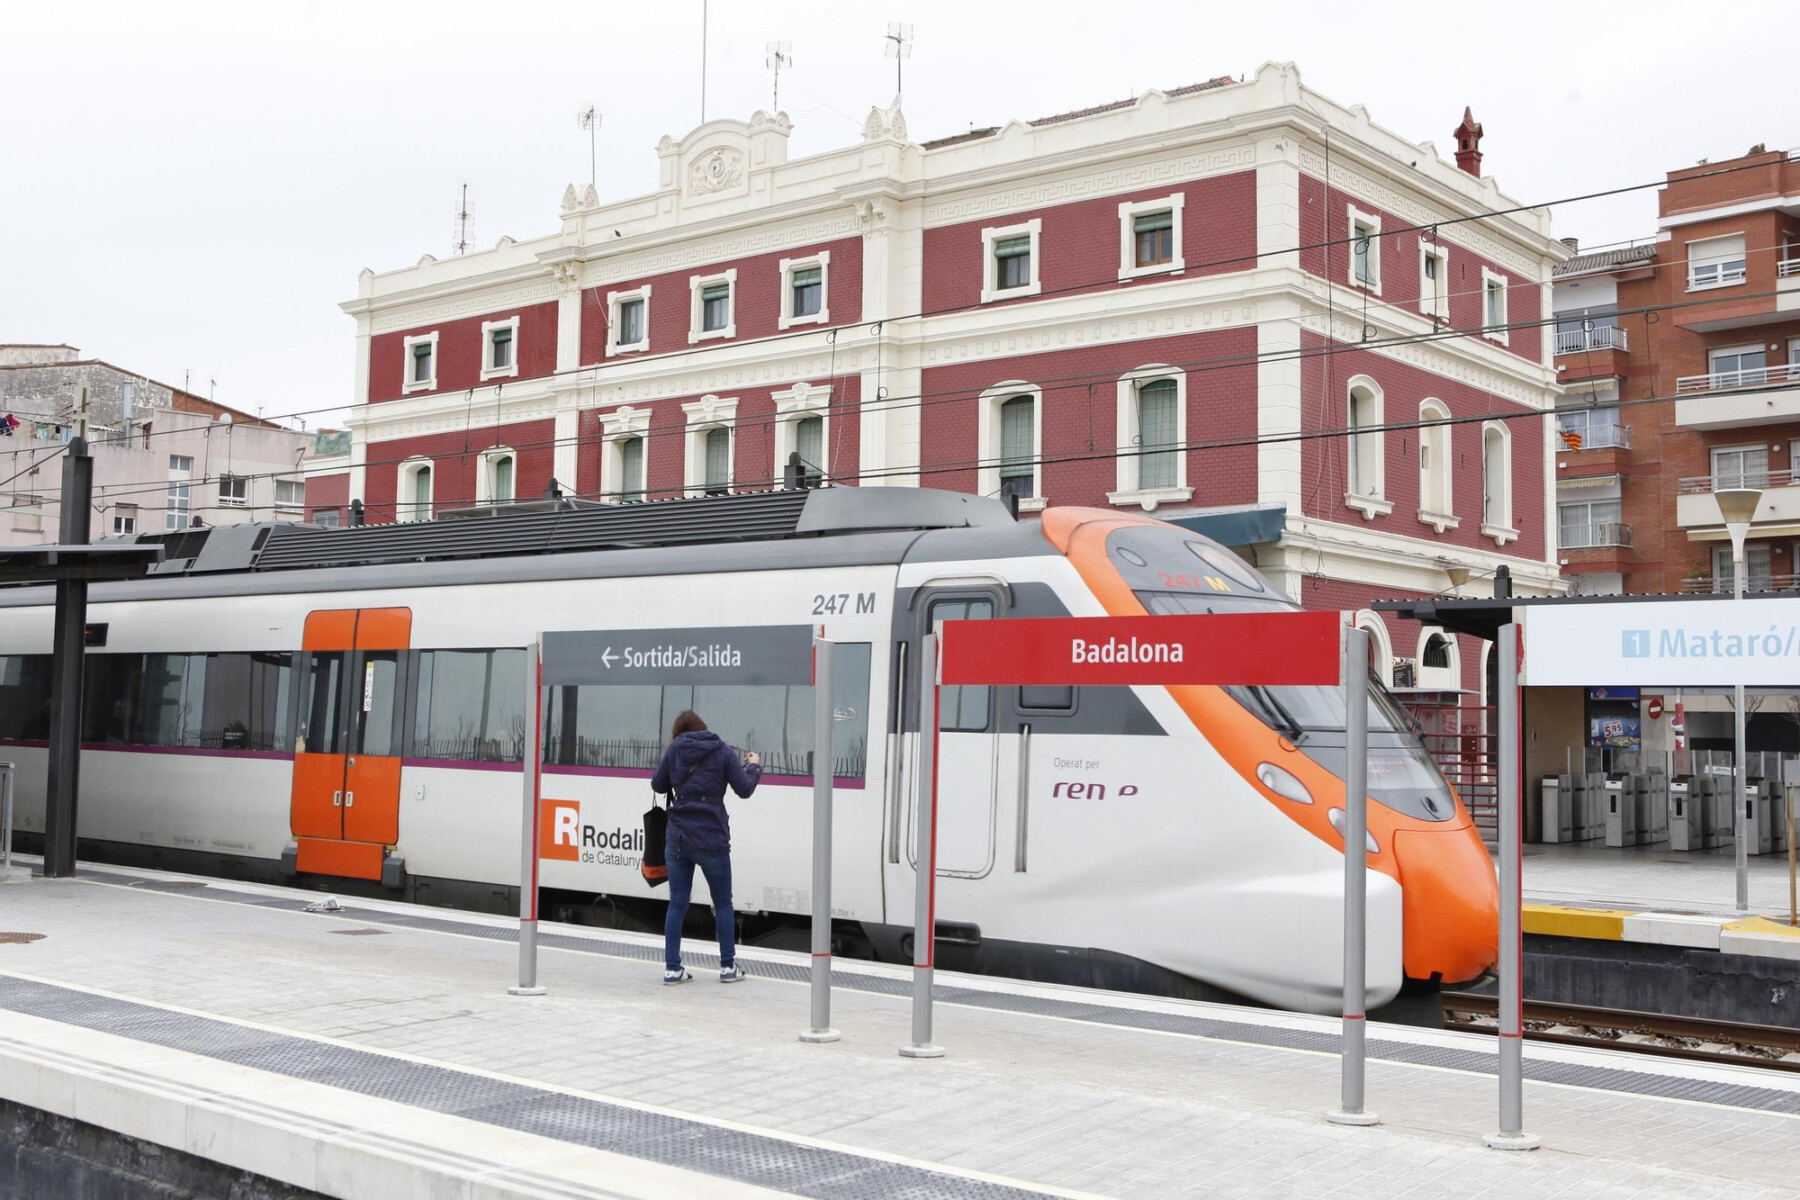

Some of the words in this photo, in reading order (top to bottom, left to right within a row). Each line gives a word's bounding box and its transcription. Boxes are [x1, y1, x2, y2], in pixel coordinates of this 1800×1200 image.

[1203, 575, 1232, 592] M
[812, 594, 850, 615] 247
[856, 592, 876, 614] M
[1072, 636, 1184, 663] Badalona
[1658, 625, 1800, 658] Mataró/
[623, 644, 741, 668] Sortida/Salida
[1053, 757, 1083, 770] Operat
[1085, 760, 1100, 771] per
[554, 806, 578, 846] R
[583, 825, 644, 851] Rodali
[582, 851, 595, 863] de
[597, 851, 641, 870] Cataluny
